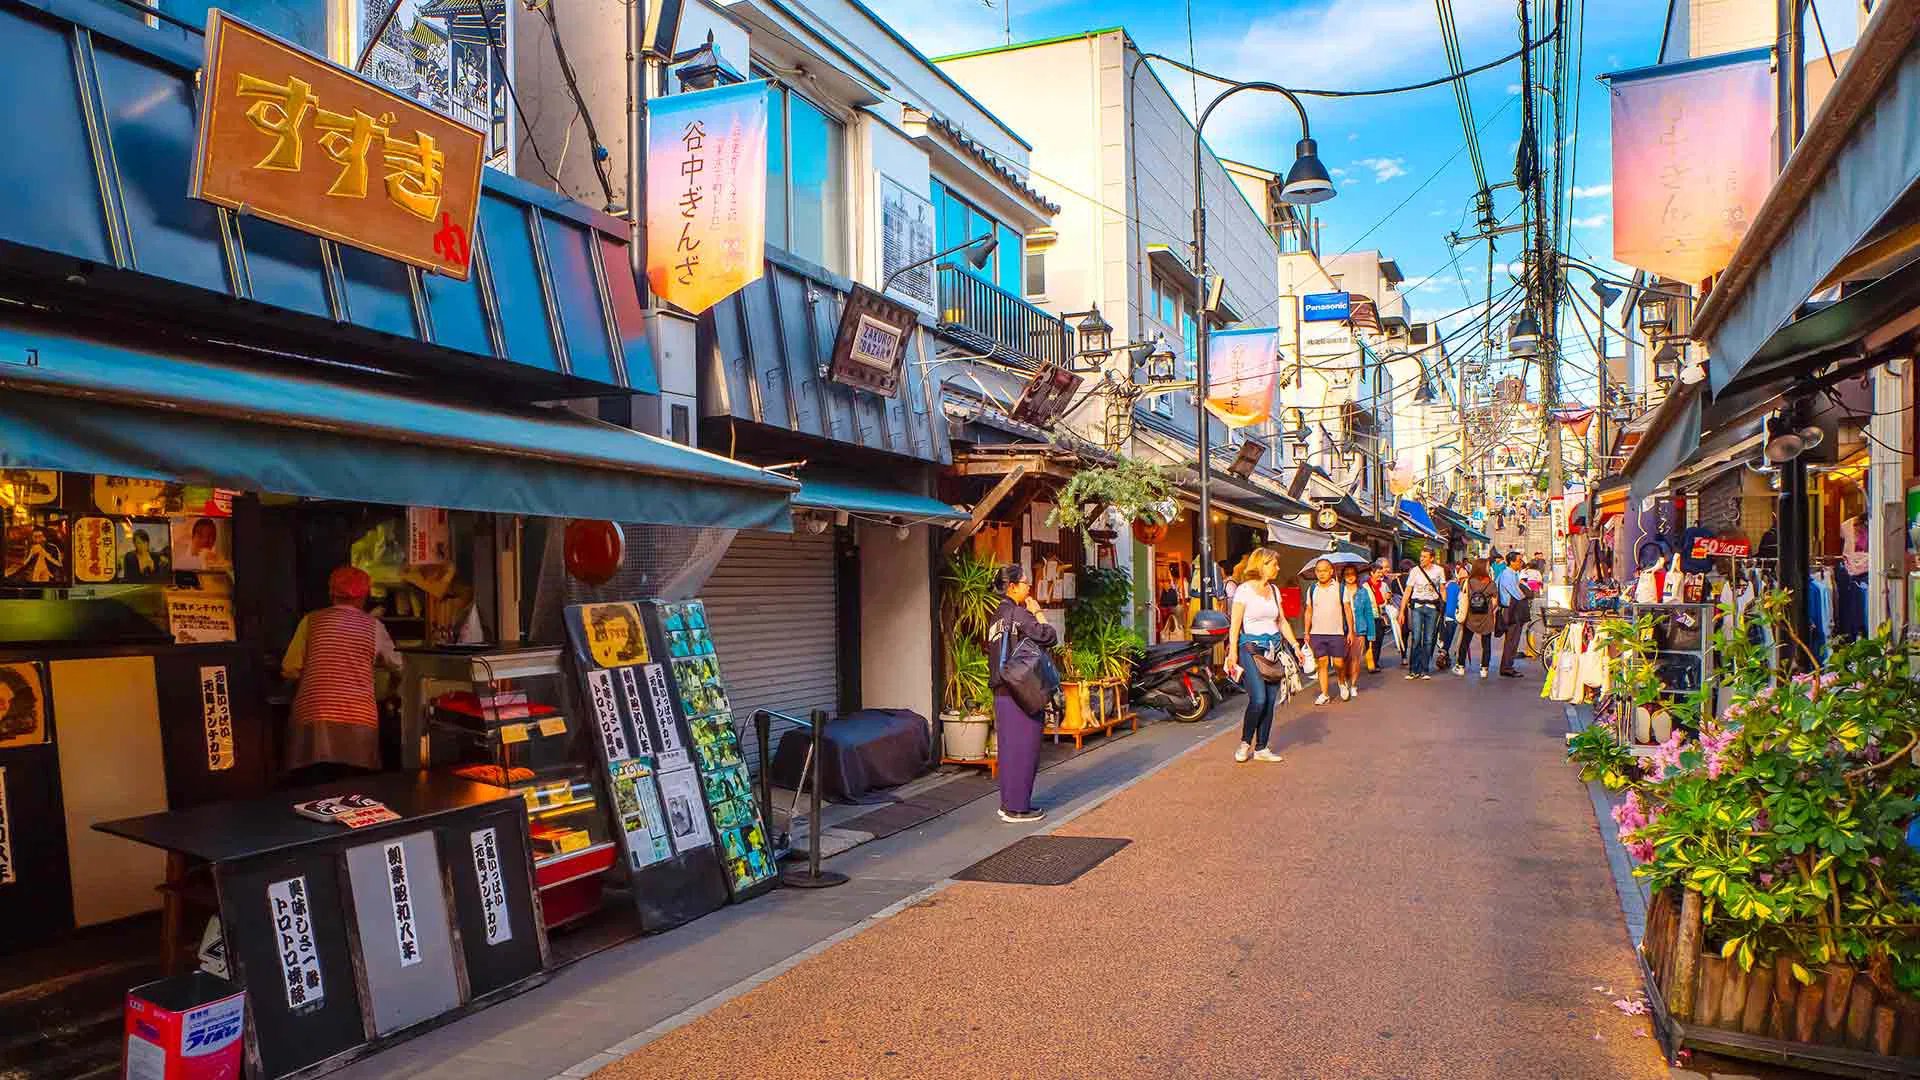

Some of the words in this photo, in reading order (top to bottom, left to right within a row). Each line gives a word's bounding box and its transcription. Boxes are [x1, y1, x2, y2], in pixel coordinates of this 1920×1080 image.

[237, 73, 445, 222] すずき
[675, 120, 706, 286] 谷中ぎんざ
[863, 325, 893, 347] ZAKURO
[1305, 302, 1347, 312] Panasonic
[386, 846, 417, 961] 創業昭和八年
